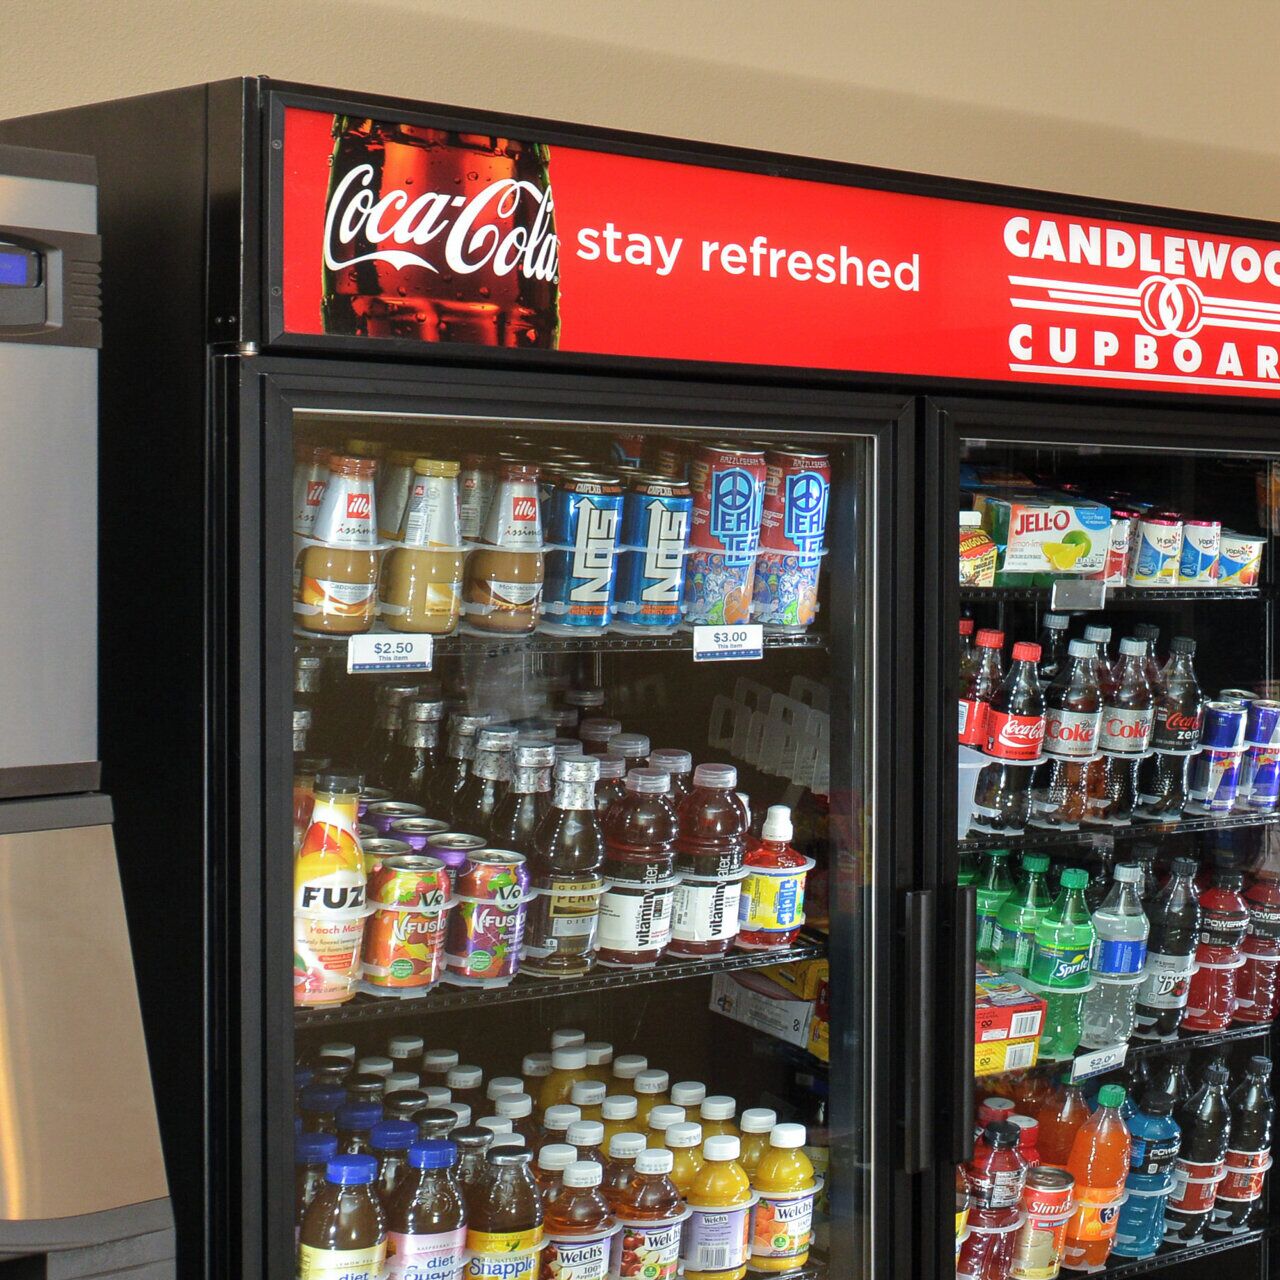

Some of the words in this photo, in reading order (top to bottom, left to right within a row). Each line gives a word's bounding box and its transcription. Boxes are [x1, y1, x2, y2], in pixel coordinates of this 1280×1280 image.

[322, 164, 560, 281] Coca-Cola
[576, 221, 682, 275] stay
[701, 235, 919, 292] refreshed
[349, 497, 370, 514] illy
[514, 500, 535, 516] illy
[714, 632, 746, 642] $3.00
[374, 642, 413, 653] $2.50
[1050, 721, 1093, 742] Coke
[1106, 718, 1150, 738] Coke
[1177, 729, 1199, 740] zero
[302, 886, 366, 907] FUZ
[1057, 961, 1089, 977] Sprite
[778, 1203, 811, 1218] Welch's
[704, 1216, 727, 1224] Welch's
[428, 1256, 454, 1268] diet
[560, 1247, 602, 1264] Welch's
[469, 1258, 535, 1279] Snapple
